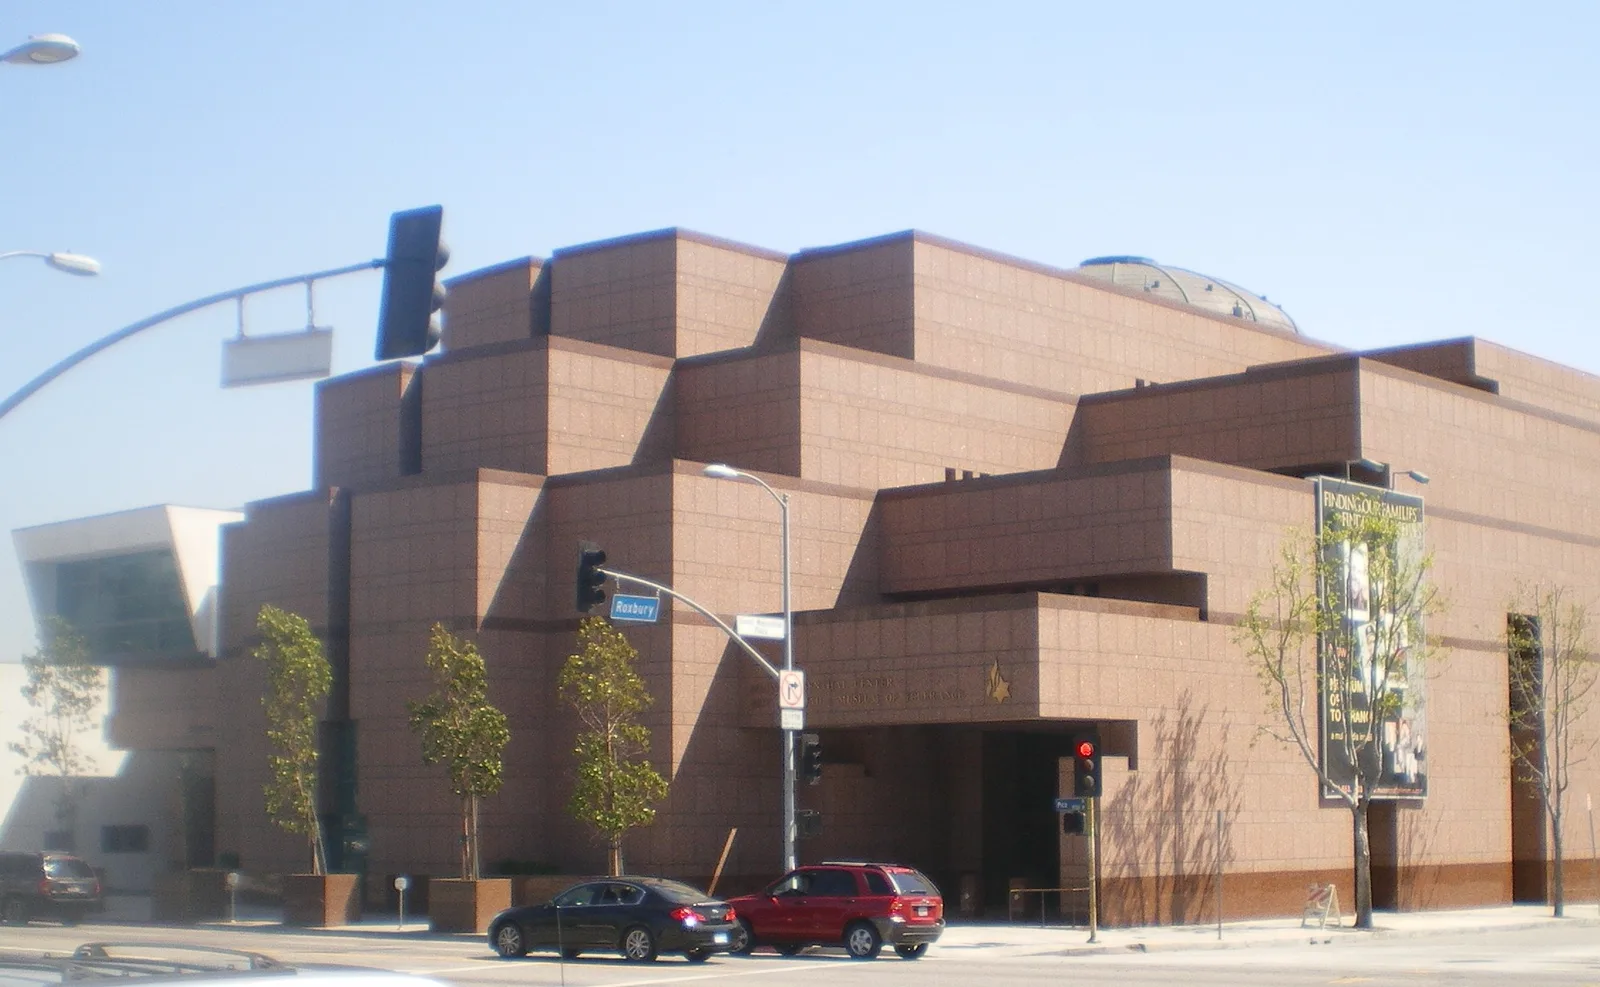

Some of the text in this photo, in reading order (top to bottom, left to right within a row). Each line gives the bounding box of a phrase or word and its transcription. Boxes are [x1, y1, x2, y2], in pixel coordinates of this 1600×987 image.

[1323, 491, 1361, 513] FINDING
[1381, 502, 1417, 523] FAMILIES
[616, 600, 655, 618] Roxbury
[1330, 709, 1373, 724] TORANC
